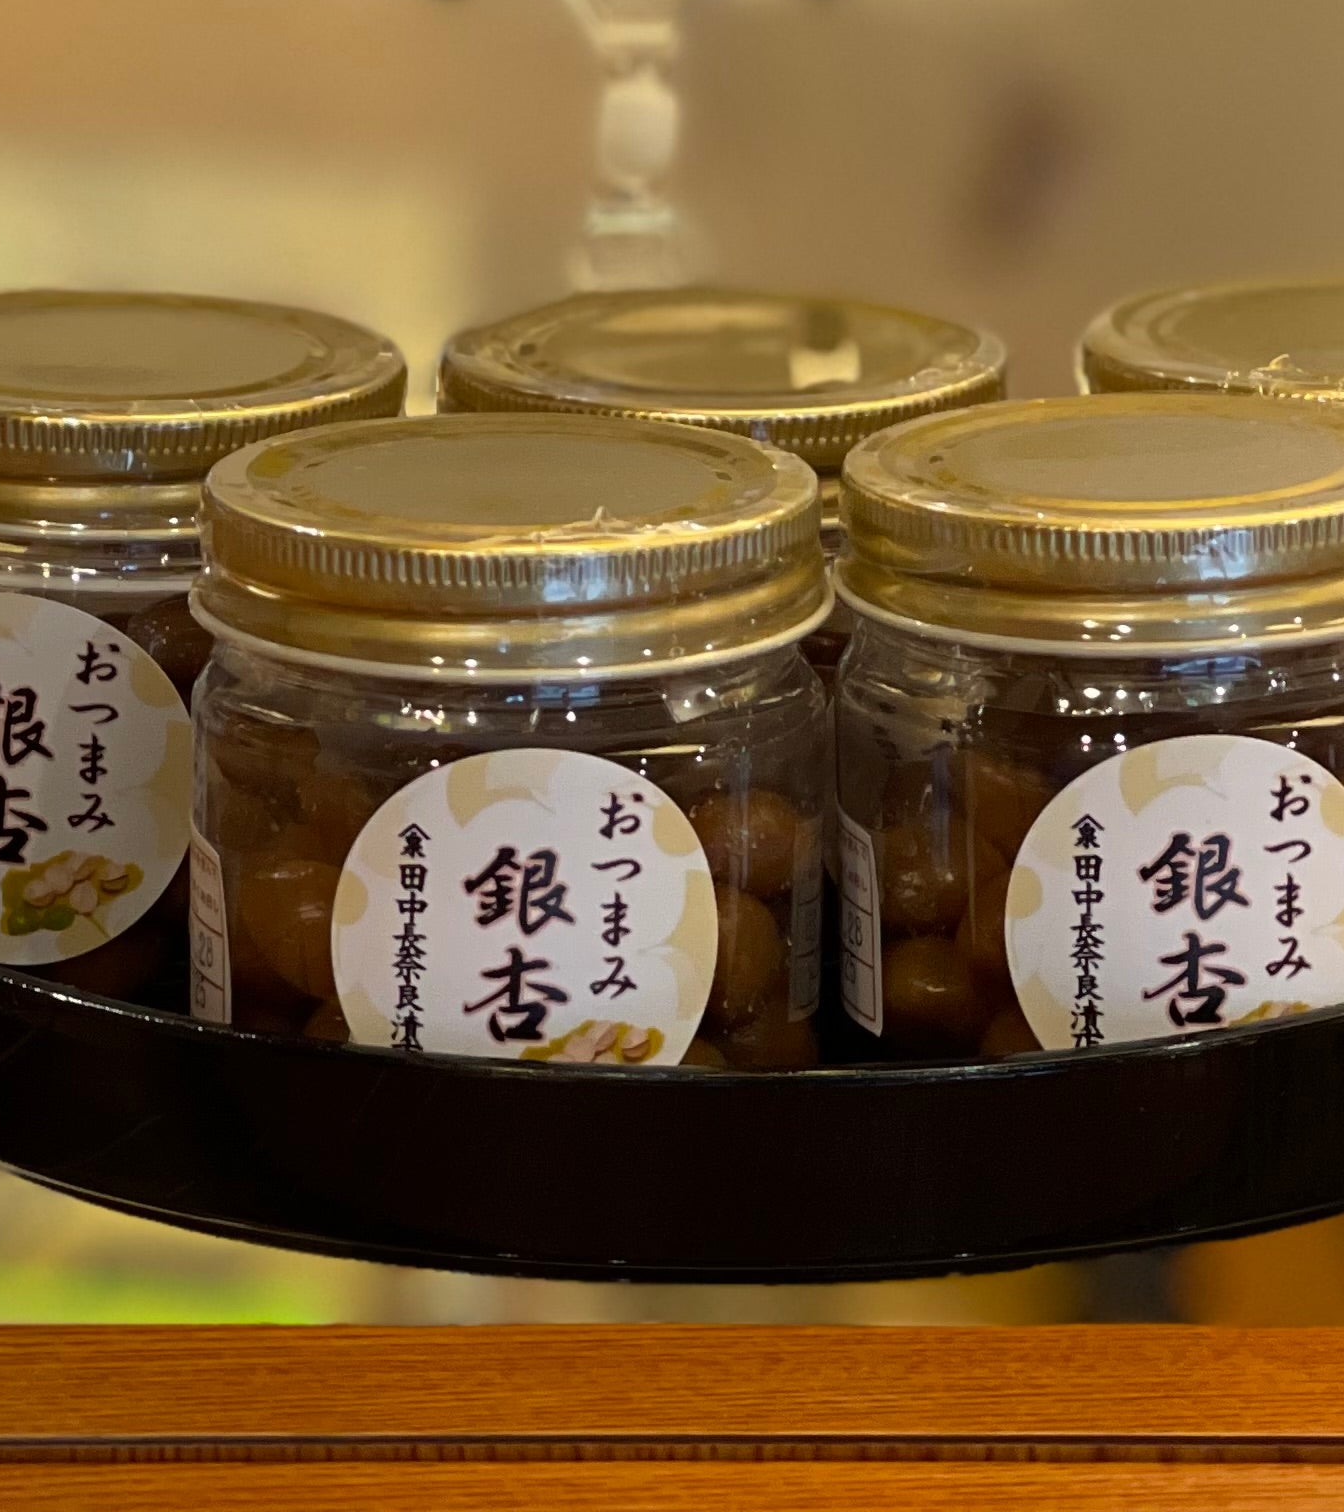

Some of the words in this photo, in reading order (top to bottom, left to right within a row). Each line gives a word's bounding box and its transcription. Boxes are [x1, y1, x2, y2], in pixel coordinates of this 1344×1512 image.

[67, 640, 121, 834] おつまみ
[463, 846, 575, 1043] 銀杏
[590, 792, 645, 1000] おつまみ
[1140, 833, 1251, 1026] 銀杏
[1265, 774, 1312, 979] おつまみ
